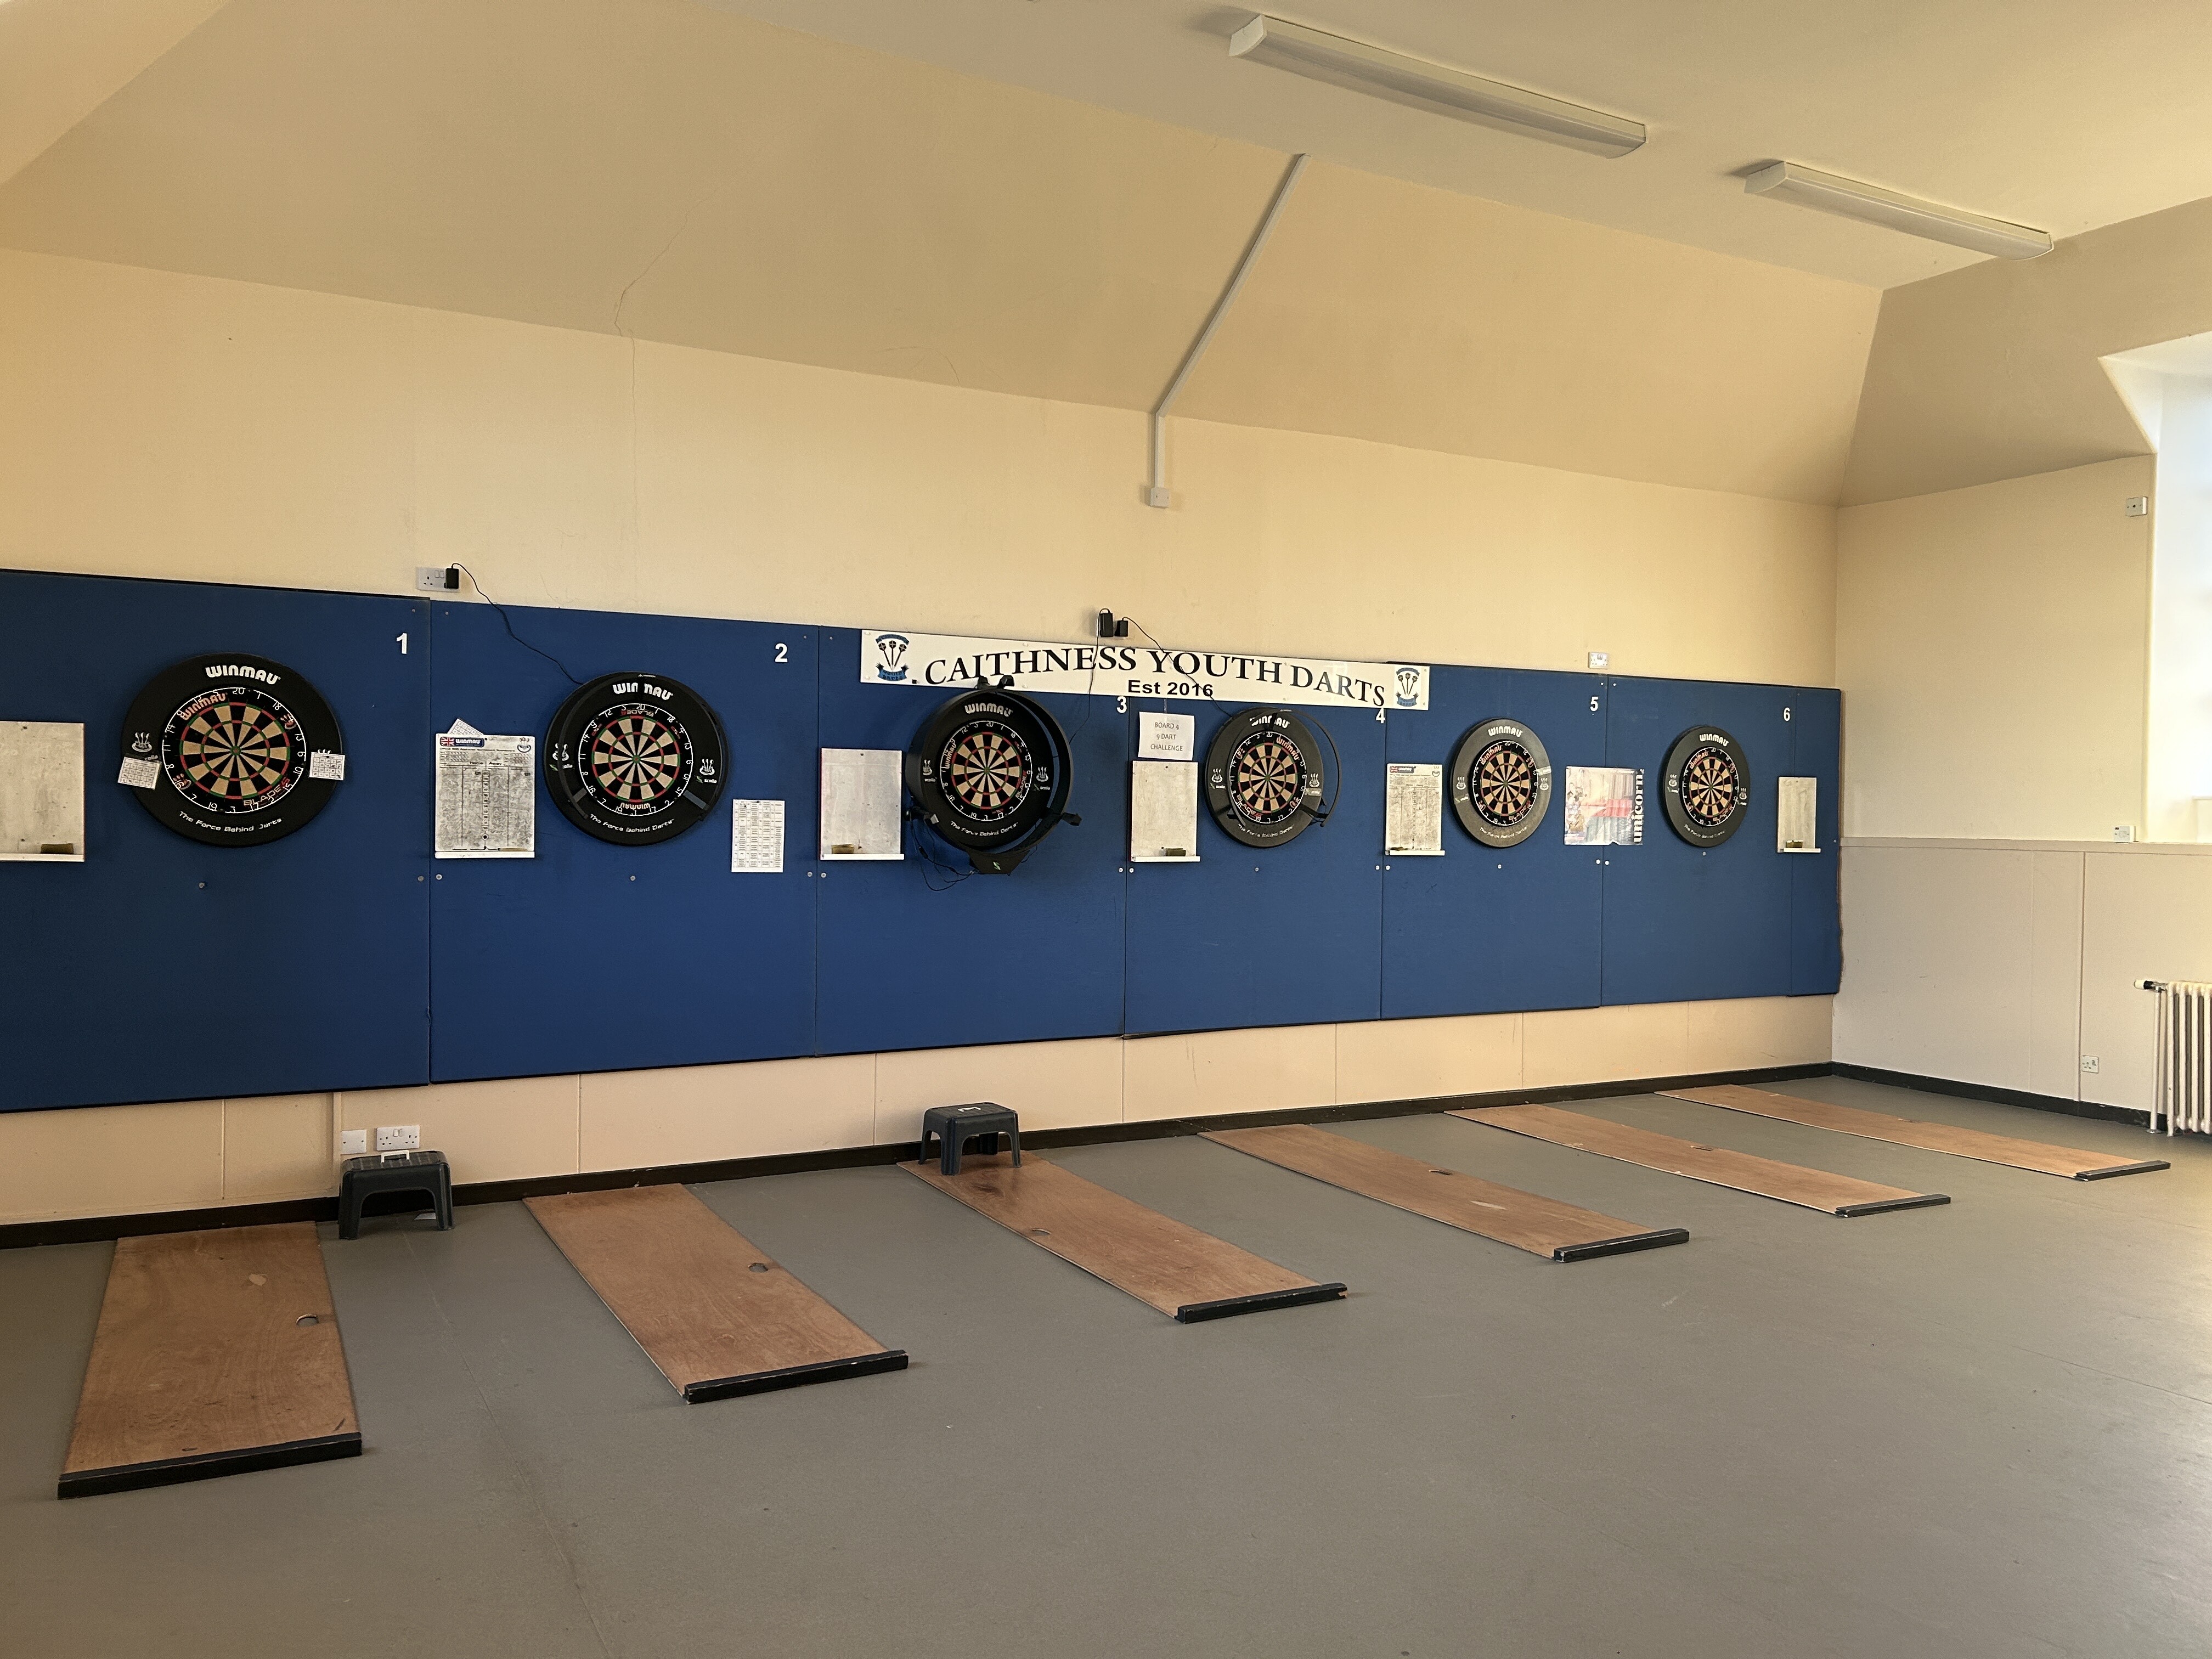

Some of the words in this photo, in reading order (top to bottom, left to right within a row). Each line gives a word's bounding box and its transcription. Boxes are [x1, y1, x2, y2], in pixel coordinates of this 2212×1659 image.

[397, 633, 407, 654] 1
[775, 643, 788, 662] 2
[205, 665, 279, 685] WINMAU
[926, 646, 1136, 685] CAITHNESS
[1147, 651, 1283, 684] YOUTH
[1290, 664, 1385, 707] DARTS
[1128, 680, 1161, 695] Est
[1167, 682, 1214, 697] 2016
[180, 693, 227, 720] WINMAU
[272, 702, 283, 710] 18
[1116, 696, 1127, 713] 3
[1590, 696, 1599, 712] 5
[604, 709, 613, 718] 12
[667, 715, 675, 723] 18
[1376, 708, 1386, 724] 4
[1783, 707, 1791, 721] 6
[165, 724, 176, 733] 14
[590, 720, 597, 729] 9
[961, 726, 968, 734] 12
[1487, 726, 1522, 737] WINMAU
[582, 733, 590, 743] 14
[1699, 733, 1729, 747] WINMAU
[684, 742, 692, 750] 13
[1150, 743, 1183, 752] CHALLENGE
[293, 766, 304, 777] 10
[283, 782, 293, 792] 15
[586, 785, 596, 794] 16
[675, 786, 684, 797] 15
[243, 785, 282, 806] BLADE
[208, 802, 218, 811] 19
[250, 802, 259, 811] 17
[614, 805, 623, 814] 19
[648, 806, 657, 815] 17
[1631, 774, 1644, 843] unicorn
[179, 811, 194, 822] The
[195, 820, 221, 831] Force
[590, 814, 602, 823] The
[602, 822, 624, 831] Force
[652, 820, 673, 831] Darts
[950, 821, 961, 830] The
